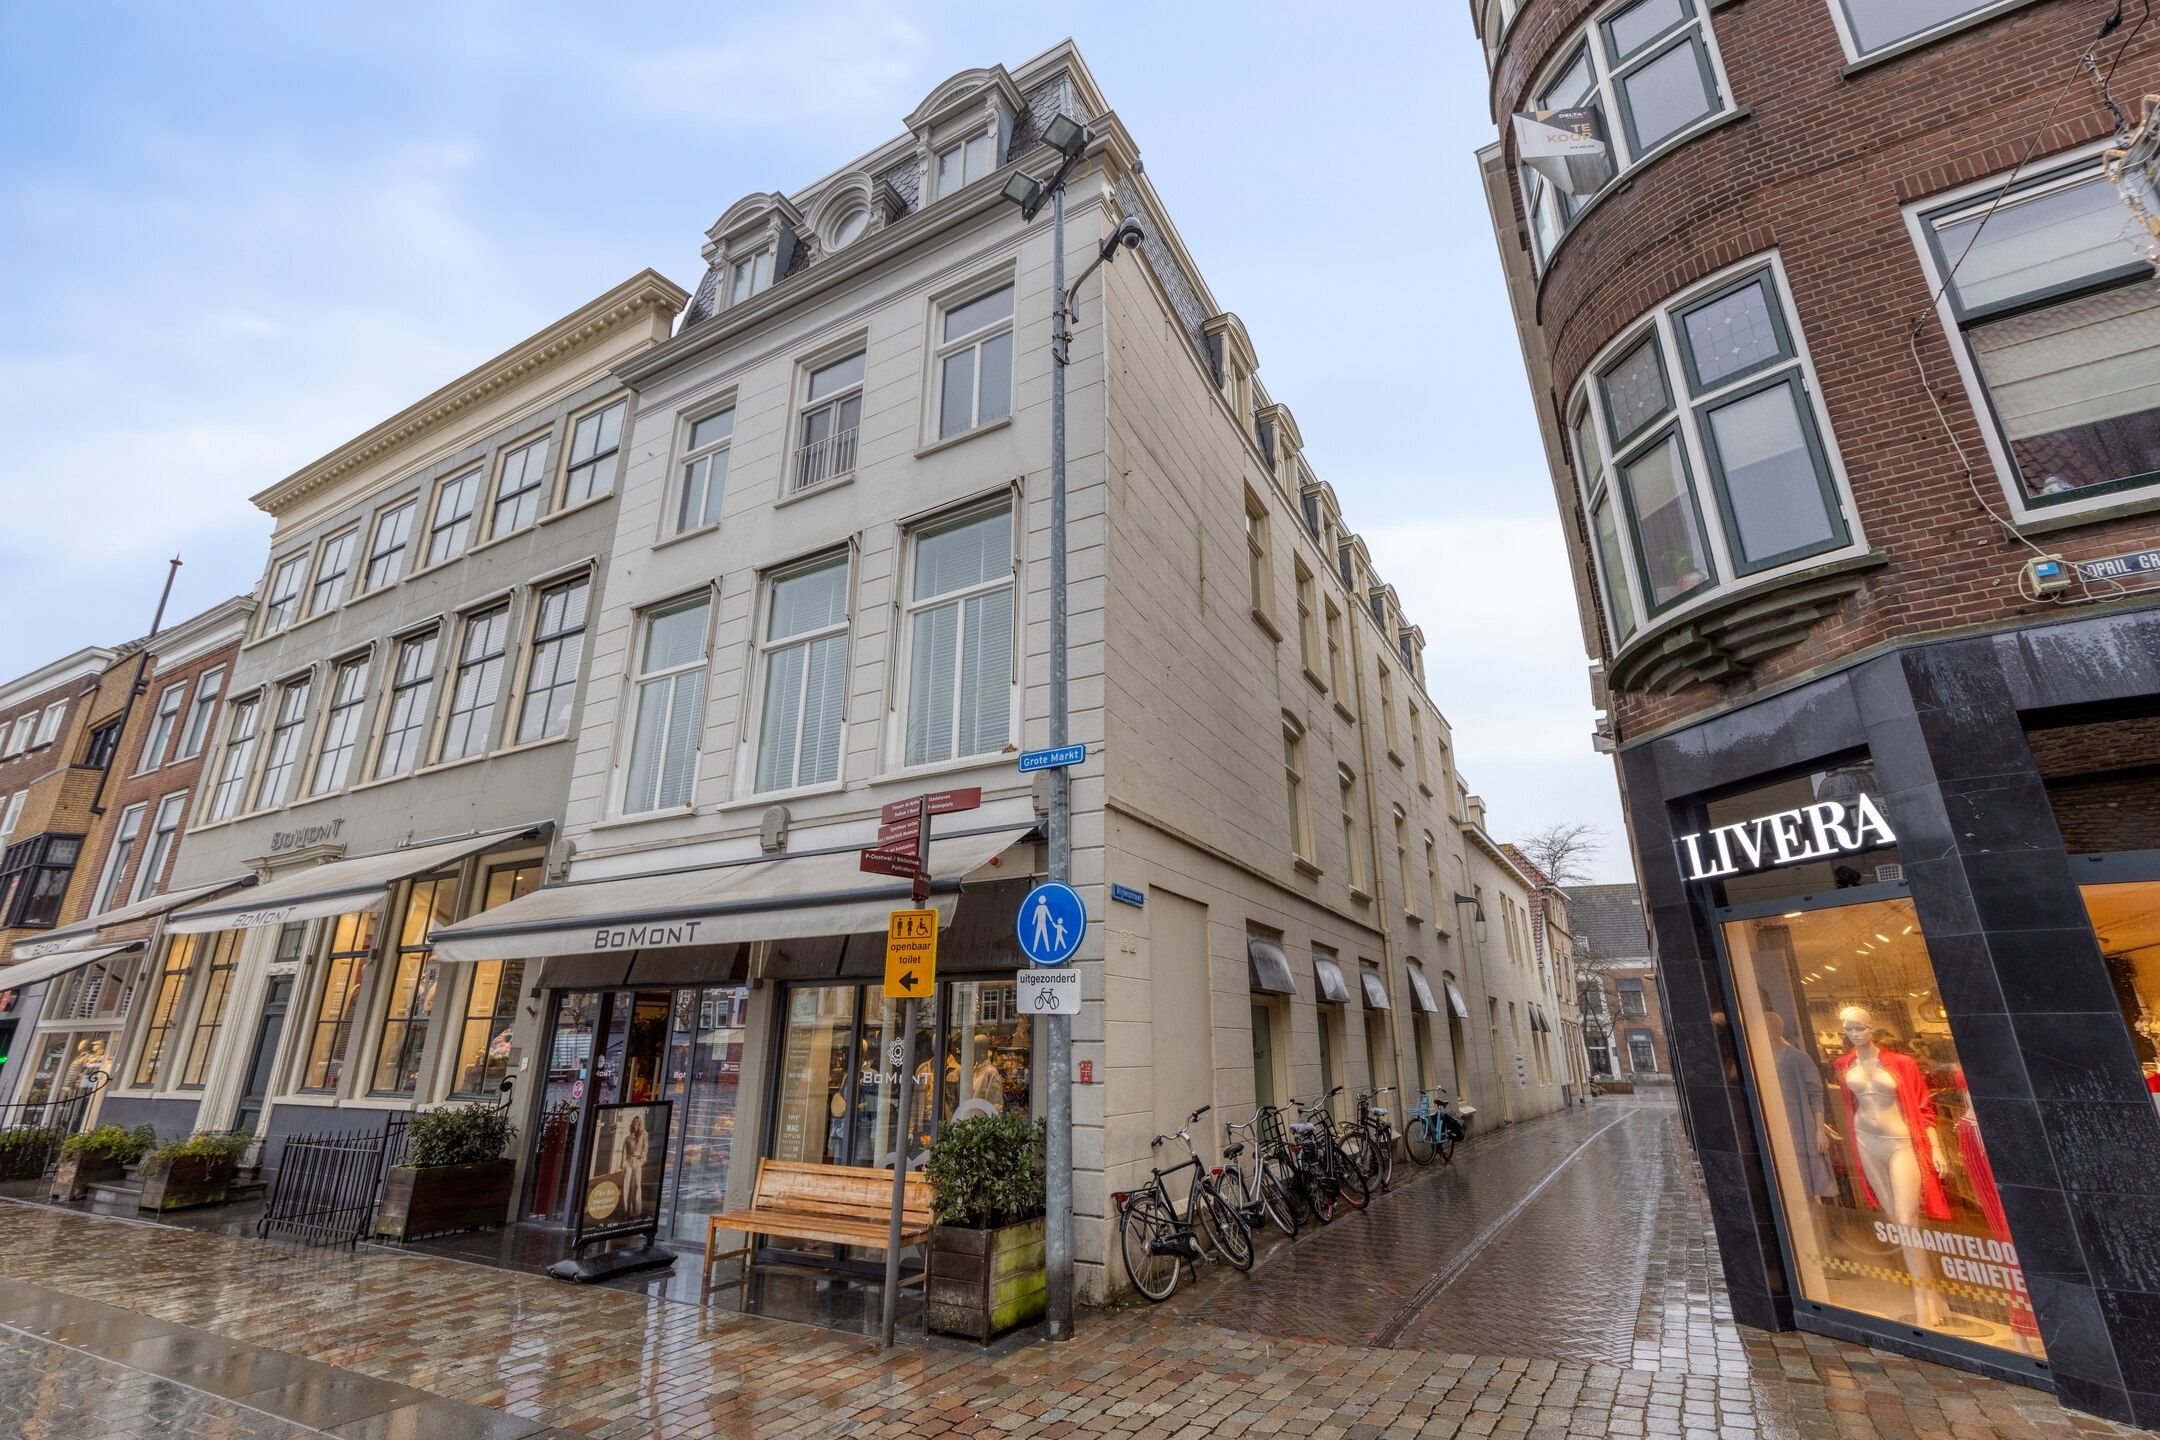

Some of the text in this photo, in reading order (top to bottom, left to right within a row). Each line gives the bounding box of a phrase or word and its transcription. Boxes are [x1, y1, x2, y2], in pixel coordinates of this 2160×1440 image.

[1570, 123, 1591, 132] TE
[1546, 132, 1592, 143] KOOP
[2138, 552, 2160, 569] GR
[1023, 750, 1079, 767] Grote Markt
[890, 824, 907, 832] Openbaar
[1680, 792, 1897, 880] LIVERA
[865, 853, 892, 861] P-Oostwal
[890, 942, 932, 952] openbaar
[899, 955, 921, 964] toilet
[1020, 973, 1076, 986] uitgezonderd
[863, 1071, 931, 1085] BOMNT
